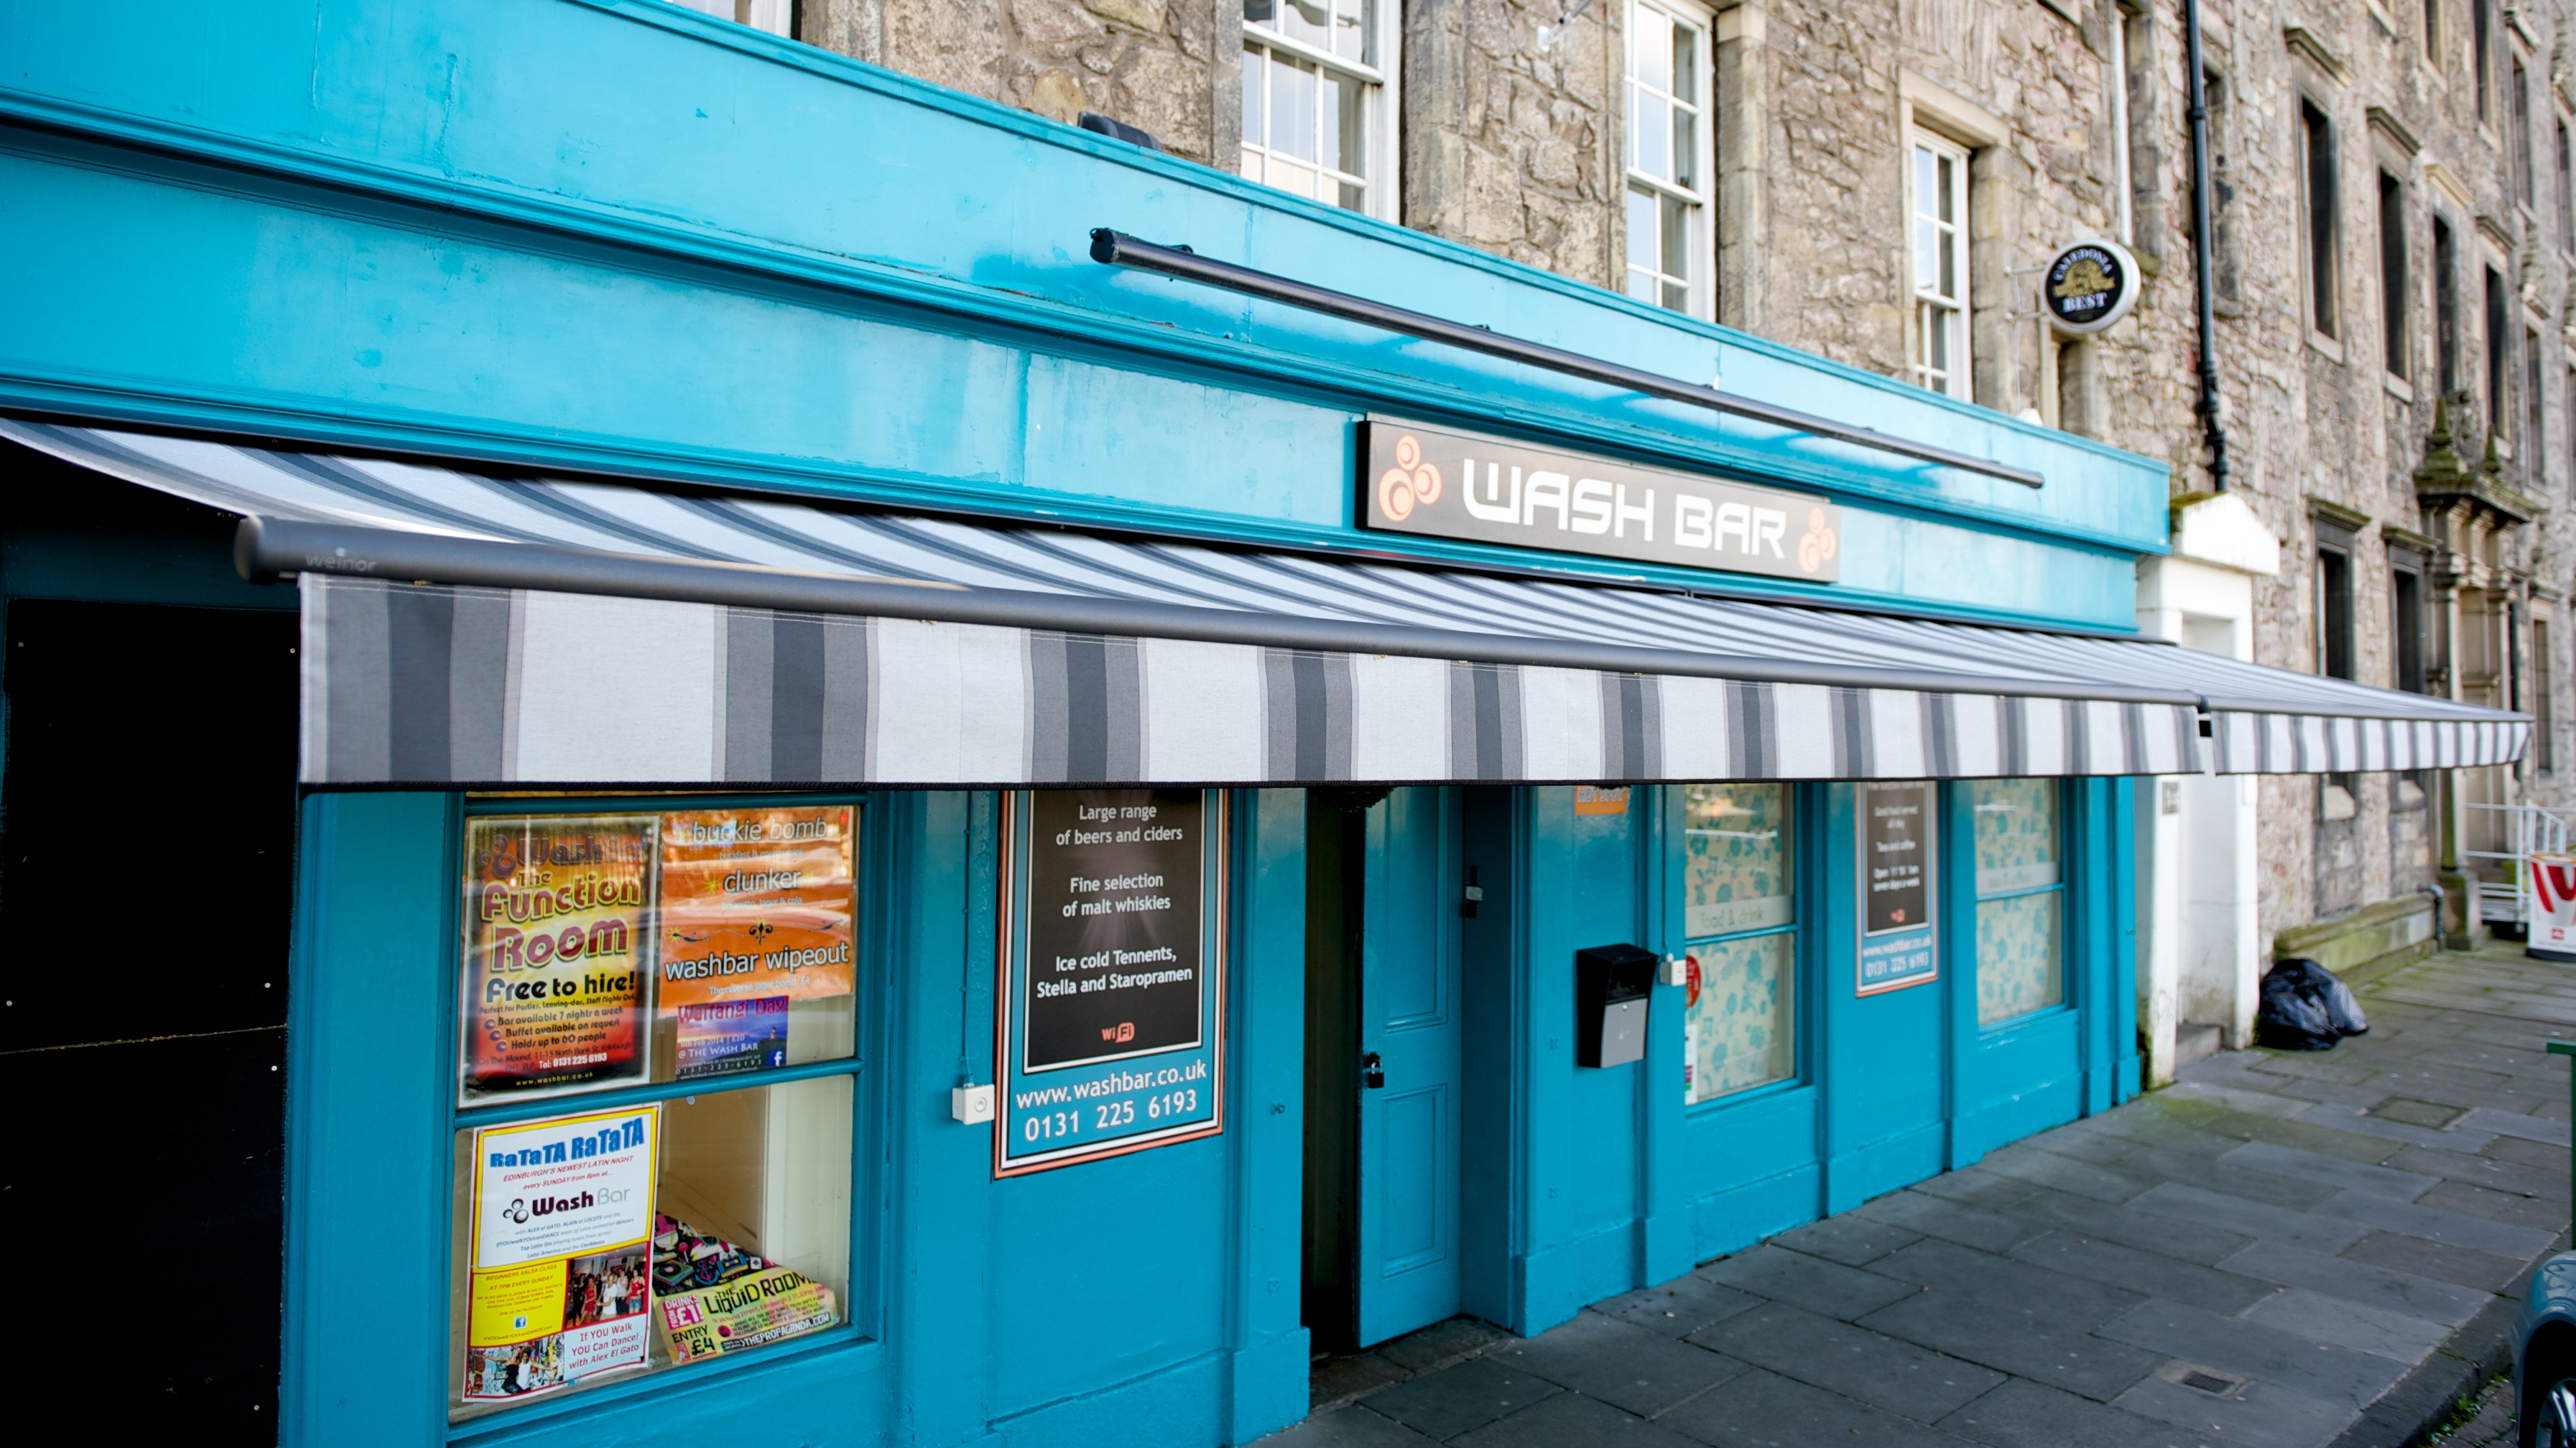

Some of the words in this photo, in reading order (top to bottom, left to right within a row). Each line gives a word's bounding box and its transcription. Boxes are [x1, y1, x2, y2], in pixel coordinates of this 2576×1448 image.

[2053, 249, 2113, 281] CALEDONIA
[2063, 292, 2107, 313] BEST
[1462, 457, 1654, 542] WASH
[1674, 493, 1786, 559] BAR
[1577, 786, 1599, 802] HOT
[1079, 804, 1117, 822] Large
[1121, 806, 1157, 821] range
[693, 817, 762, 843] buckie
[769, 815, 828, 841] bomb
[1056, 829, 1071, 845] of
[1075, 829, 1112, 845] beers
[1116, 827, 1140, 842] and
[1144, 826, 1182, 841] ciders
[518, 869, 552, 887] The
[723, 868, 802, 893] clunker
[1070, 877, 1100, 893] Fine
[1104, 873, 1164, 891] selection
[482, 871, 641, 922] Function
[1063, 901, 1077, 917] of
[1081, 899, 1111, 915] malt
[1115, 895, 1170, 912] whiskies
[665, 952, 759, 981] washbar
[765, 942, 849, 973] wipeout
[1056, 956, 1077, 971] Ice
[1080, 951, 1109, 969] cold
[1113, 946, 1177, 966] Tennents,
[552, 978, 577, 996] to
[584, 970, 635, 995] hire!
[709, 986, 724, 996] The
[776, 978, 797, 988] bomb
[1037, 979, 1077, 998] Stella
[1080, 974, 1106, 993] and
[1110, 968, 1193, 989] Staropramen
[497, 1017, 514, 1026] Bar
[515, 1012, 557, 1024] available
[559, 1010, 565, 1019] 7
[566, 1008, 592, 1021] nights
[601, 1006, 624, 1016] week
[678, 1000, 749, 1024] Waitangi
[754, 996, 790, 1016] Day!
[505, 1028, 533, 1038] Buffet
[534, 1023, 576, 1034] available
[591, 1019, 620, 1030] request
[511, 1038, 536, 1049] Holds
[561, 1034, 576, 1044] 60
[577, 1031, 607, 1044] people
[688, 1048, 707, 1058] THE
[710, 1044, 738, 1056] WASH
[741, 1042, 759, 1053] BAR
[707, 1037, 724, 1046] 2014
[732, 1034, 745, 1043] £10
[538, 1061, 552, 1069] Tel:
[552, 1056, 571, 1067] 0131
[572, 1054, 587, 1065] 225
[589, 1052, 607, 1062] 6193
[515, 1071, 594, 1086] www.washbar.co.uk
[1015, 1058, 1207, 1110] www.washbar.co.uk
[1025, 1110, 1079, 1142] 0131
[1096, 1100, 1135, 1129] 225
[1148, 1088, 1197, 1119] 6193
[490, 1141, 567, 1168] RaTaTA
[571, 1116, 645, 1160] RaTaTA
[503, 1167, 556, 1182] EDINBURGH'S
[556, 1162, 587, 1174] NEWEST
[587, 1158, 610, 1168] LATIN
[610, 1155, 634, 1165] NIGHT
[523, 1182, 541, 1190] every
[541, 1176, 571, 1187] SUNDAY
[571, 1174, 585, 1183] from
[586, 1171, 600, 1181] 8pm
[616, 1218, 635, 1226] dancers
[580, 1239, 605, 1248] Caribbean
[486, 1271, 519, 1282] BEGINNERS
[540, 1264, 557, 1272] CLASS
[512, 1280, 531, 1288] EVERY
[531, 1274, 554, 1283] SUNDAY
[717, 1289, 736, 1299] THE
[760, 1271, 818, 1297] ROOM
[665, 1294, 699, 1310] DRINKS
[677, 1303, 705, 1326] £1!
[580, 1332, 588, 1341] If
[590, 1327, 608, 1339] YOU
[611, 1322, 633, 1334] Walk
[672, 1324, 707, 1343] ENTRY
[571, 1345, 590, 1356] YOU
[592, 1341, 608, 1351] Can
[611, 1332, 639, 1347] Dance!
[691, 1337, 716, 1356] £4
[569, 1358, 588, 1369] with
[590, 1353, 608, 1363] Alex
[610, 1348, 618, 1357] El
[621, 1345, 639, 1355] Gato
